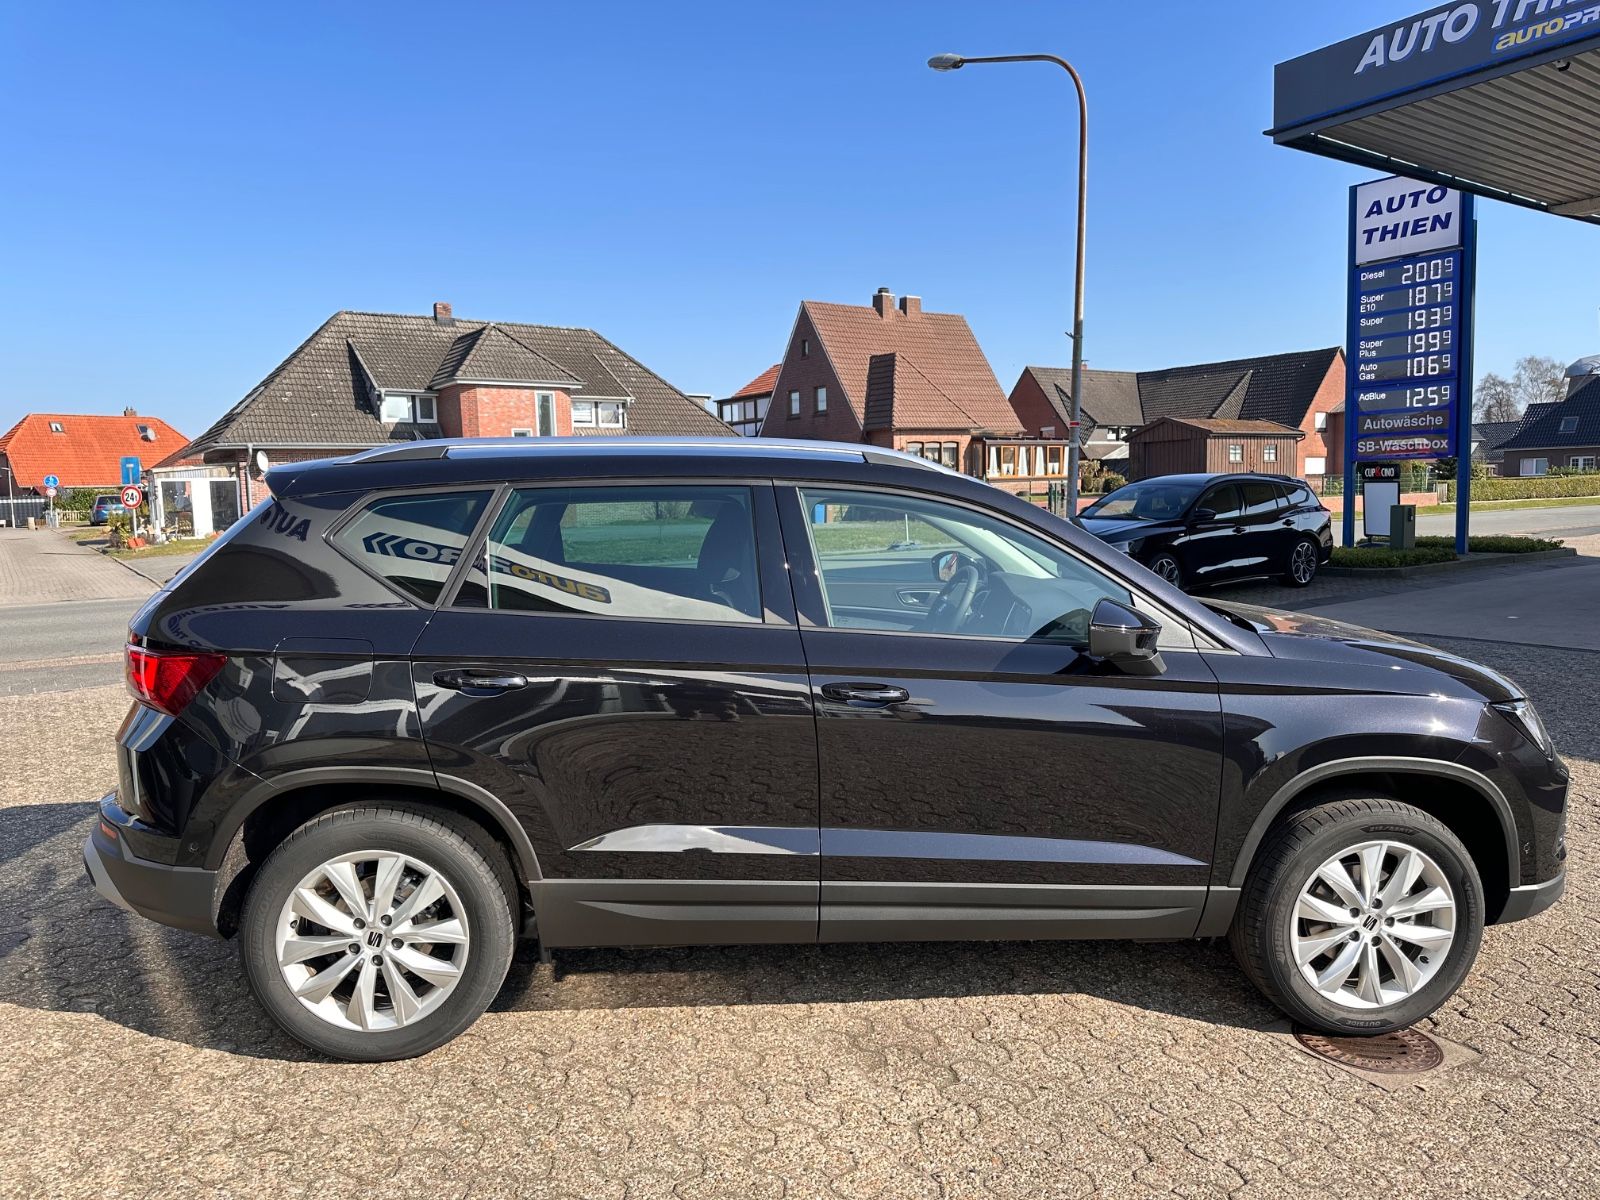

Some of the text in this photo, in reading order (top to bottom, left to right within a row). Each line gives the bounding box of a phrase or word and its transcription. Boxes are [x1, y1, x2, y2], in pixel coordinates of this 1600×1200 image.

[1353, 3, 1478, 74] AUTO
[1364, 186, 1448, 218] AUTO
[1362, 212, 1452, 245] THIEN
[1360, 269, 1385, 281] Diesel
[1360, 293, 1384, 304] Super
[1360, 304, 1376, 312] E10
[1360, 316, 1384, 326] Super
[1360, 340, 1383, 350] Super
[1360, 350, 1377, 358] Plus
[1360, 363, 1378, 372] Auto
[1359, 392, 1386, 401] AdBlue
[1364, 414, 1444, 430] Autowäsche
[1357, 438, 1449, 453] SB-Waschbox
